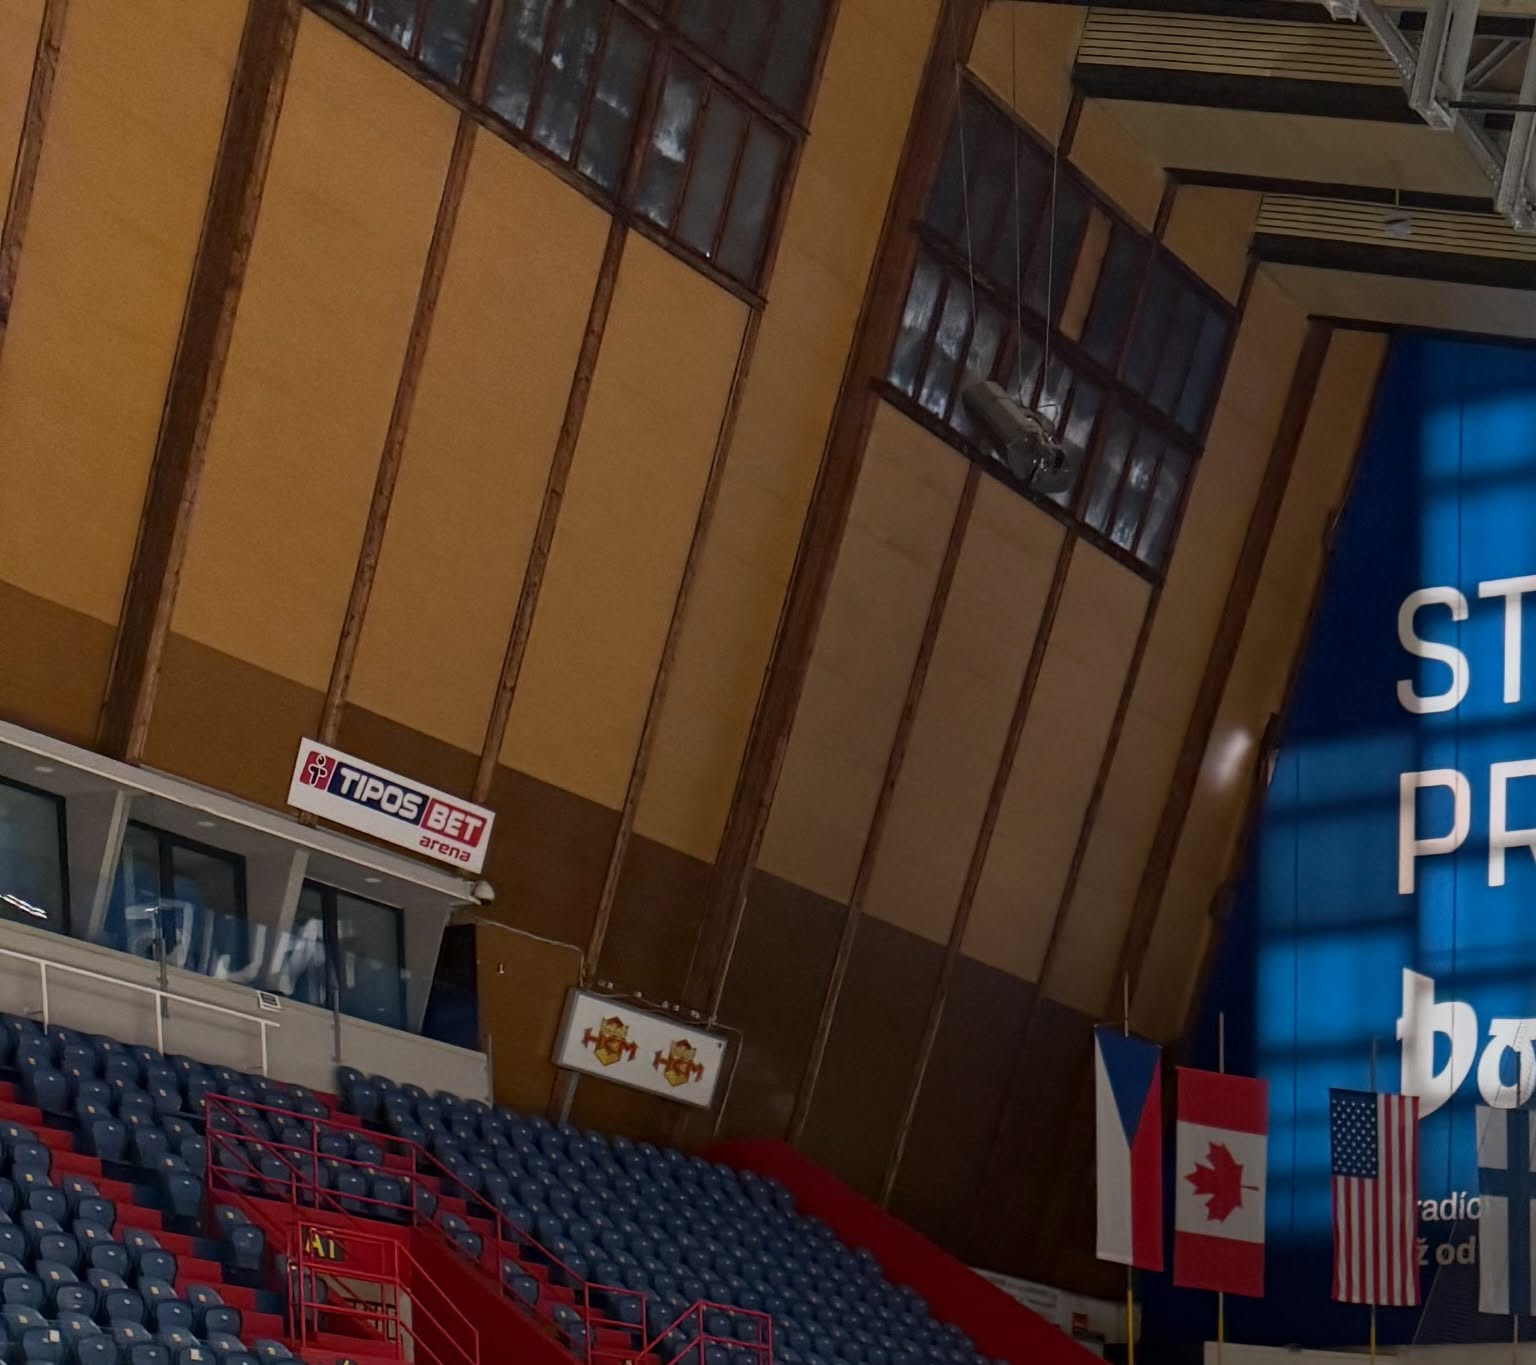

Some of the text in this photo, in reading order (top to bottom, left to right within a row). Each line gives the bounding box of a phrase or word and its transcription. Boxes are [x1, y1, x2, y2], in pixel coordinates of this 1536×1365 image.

[339, 767, 483, 842] TIPOS BET
[418, 835, 471, 863] arena
